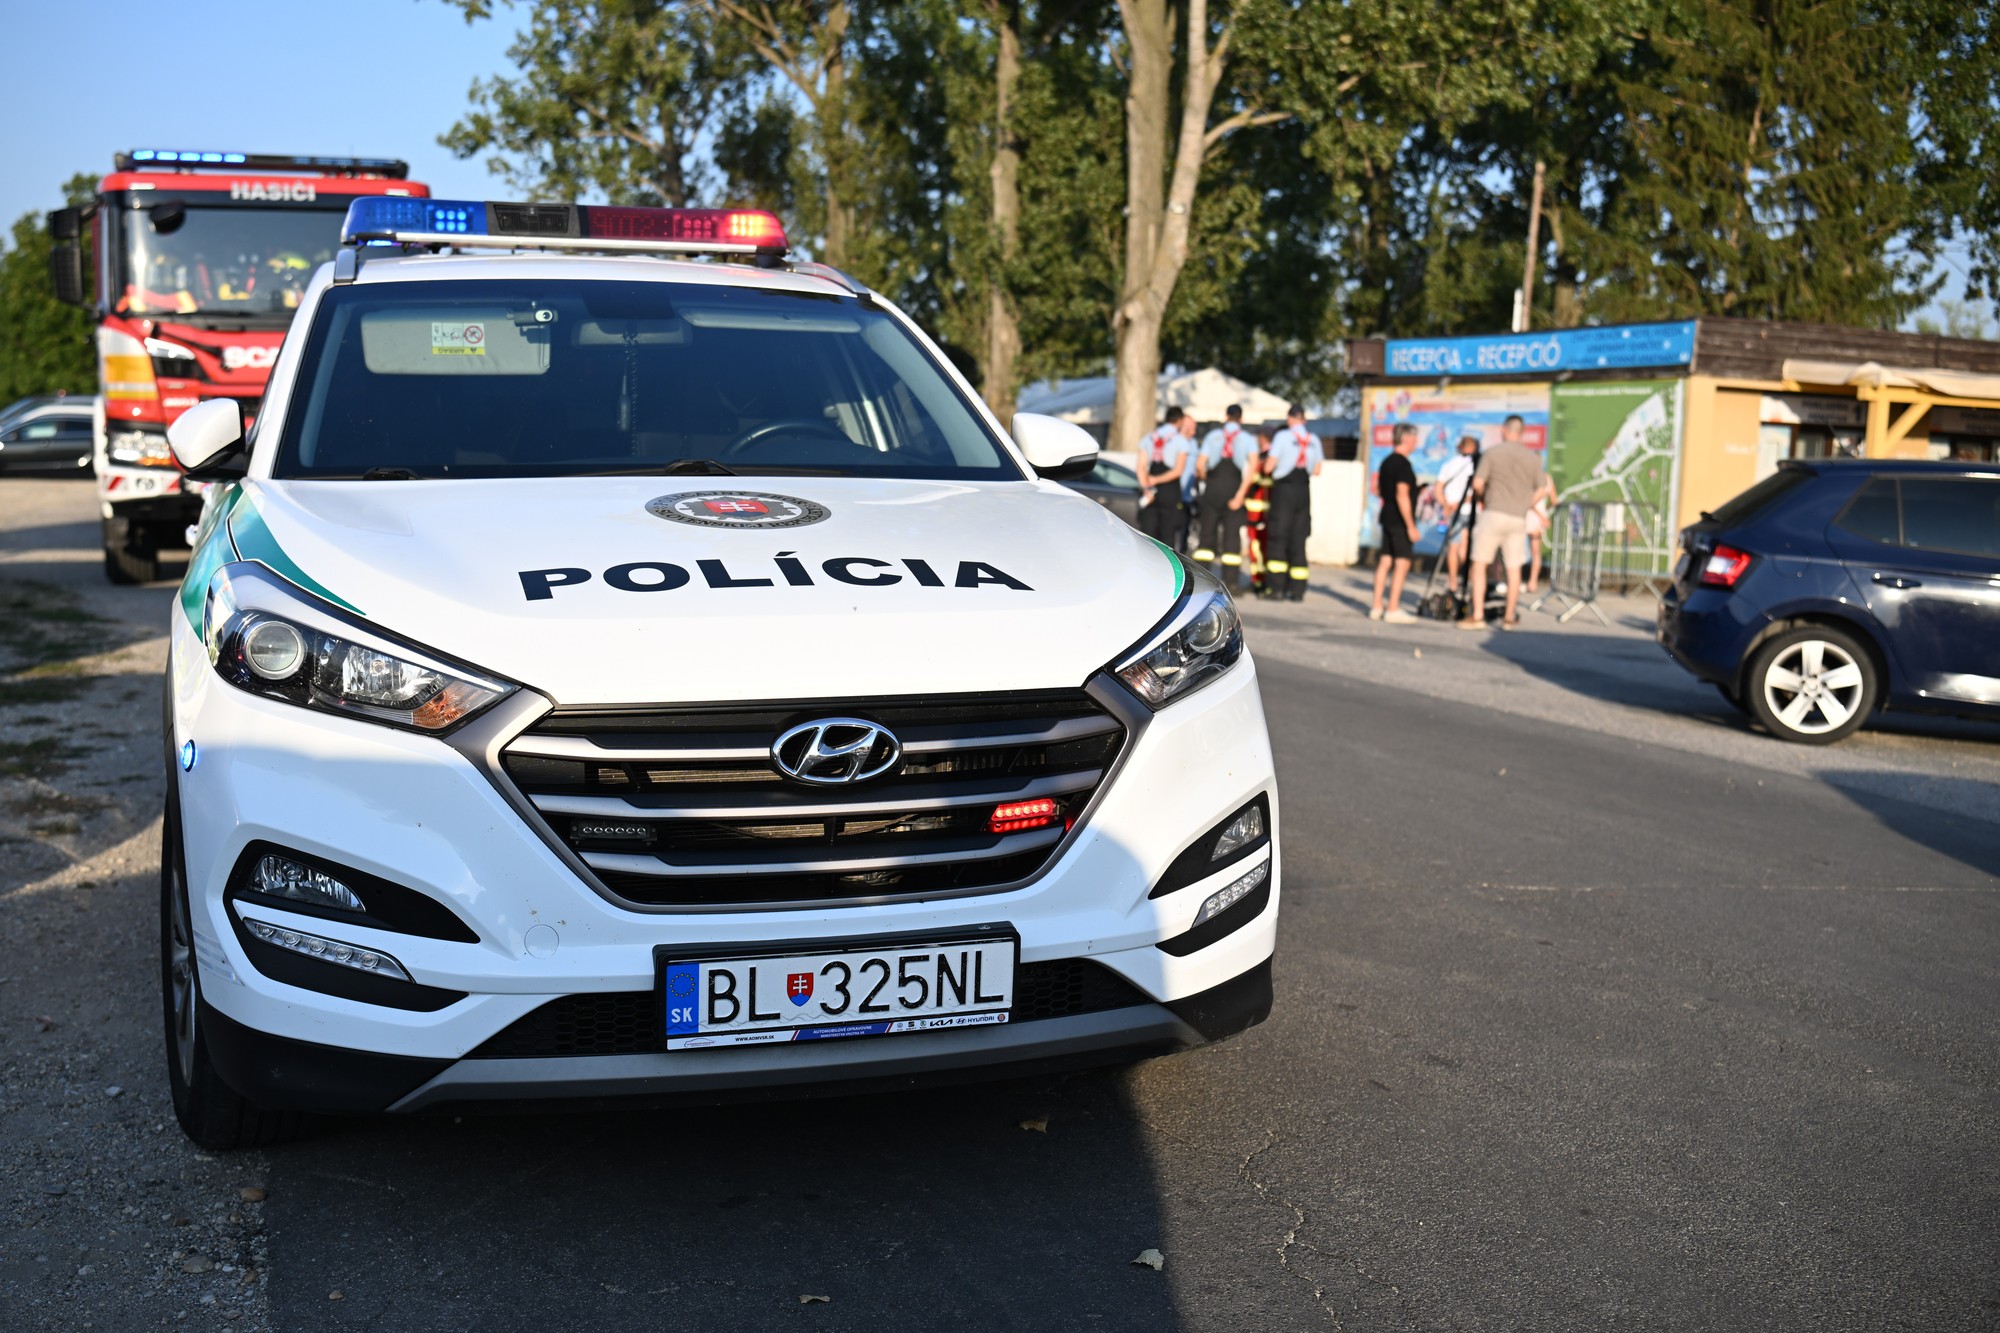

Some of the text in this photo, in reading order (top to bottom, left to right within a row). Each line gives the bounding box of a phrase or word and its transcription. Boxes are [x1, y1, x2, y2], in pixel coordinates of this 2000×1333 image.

[230, 180, 317, 202] HASIČI
[518, 551, 1036, 601] POLÍCIA
[707, 950, 1004, 1025] BL 325NL
[671, 1007, 693, 1024] SK
[967, 1015, 995, 1023] HYUNDAI
